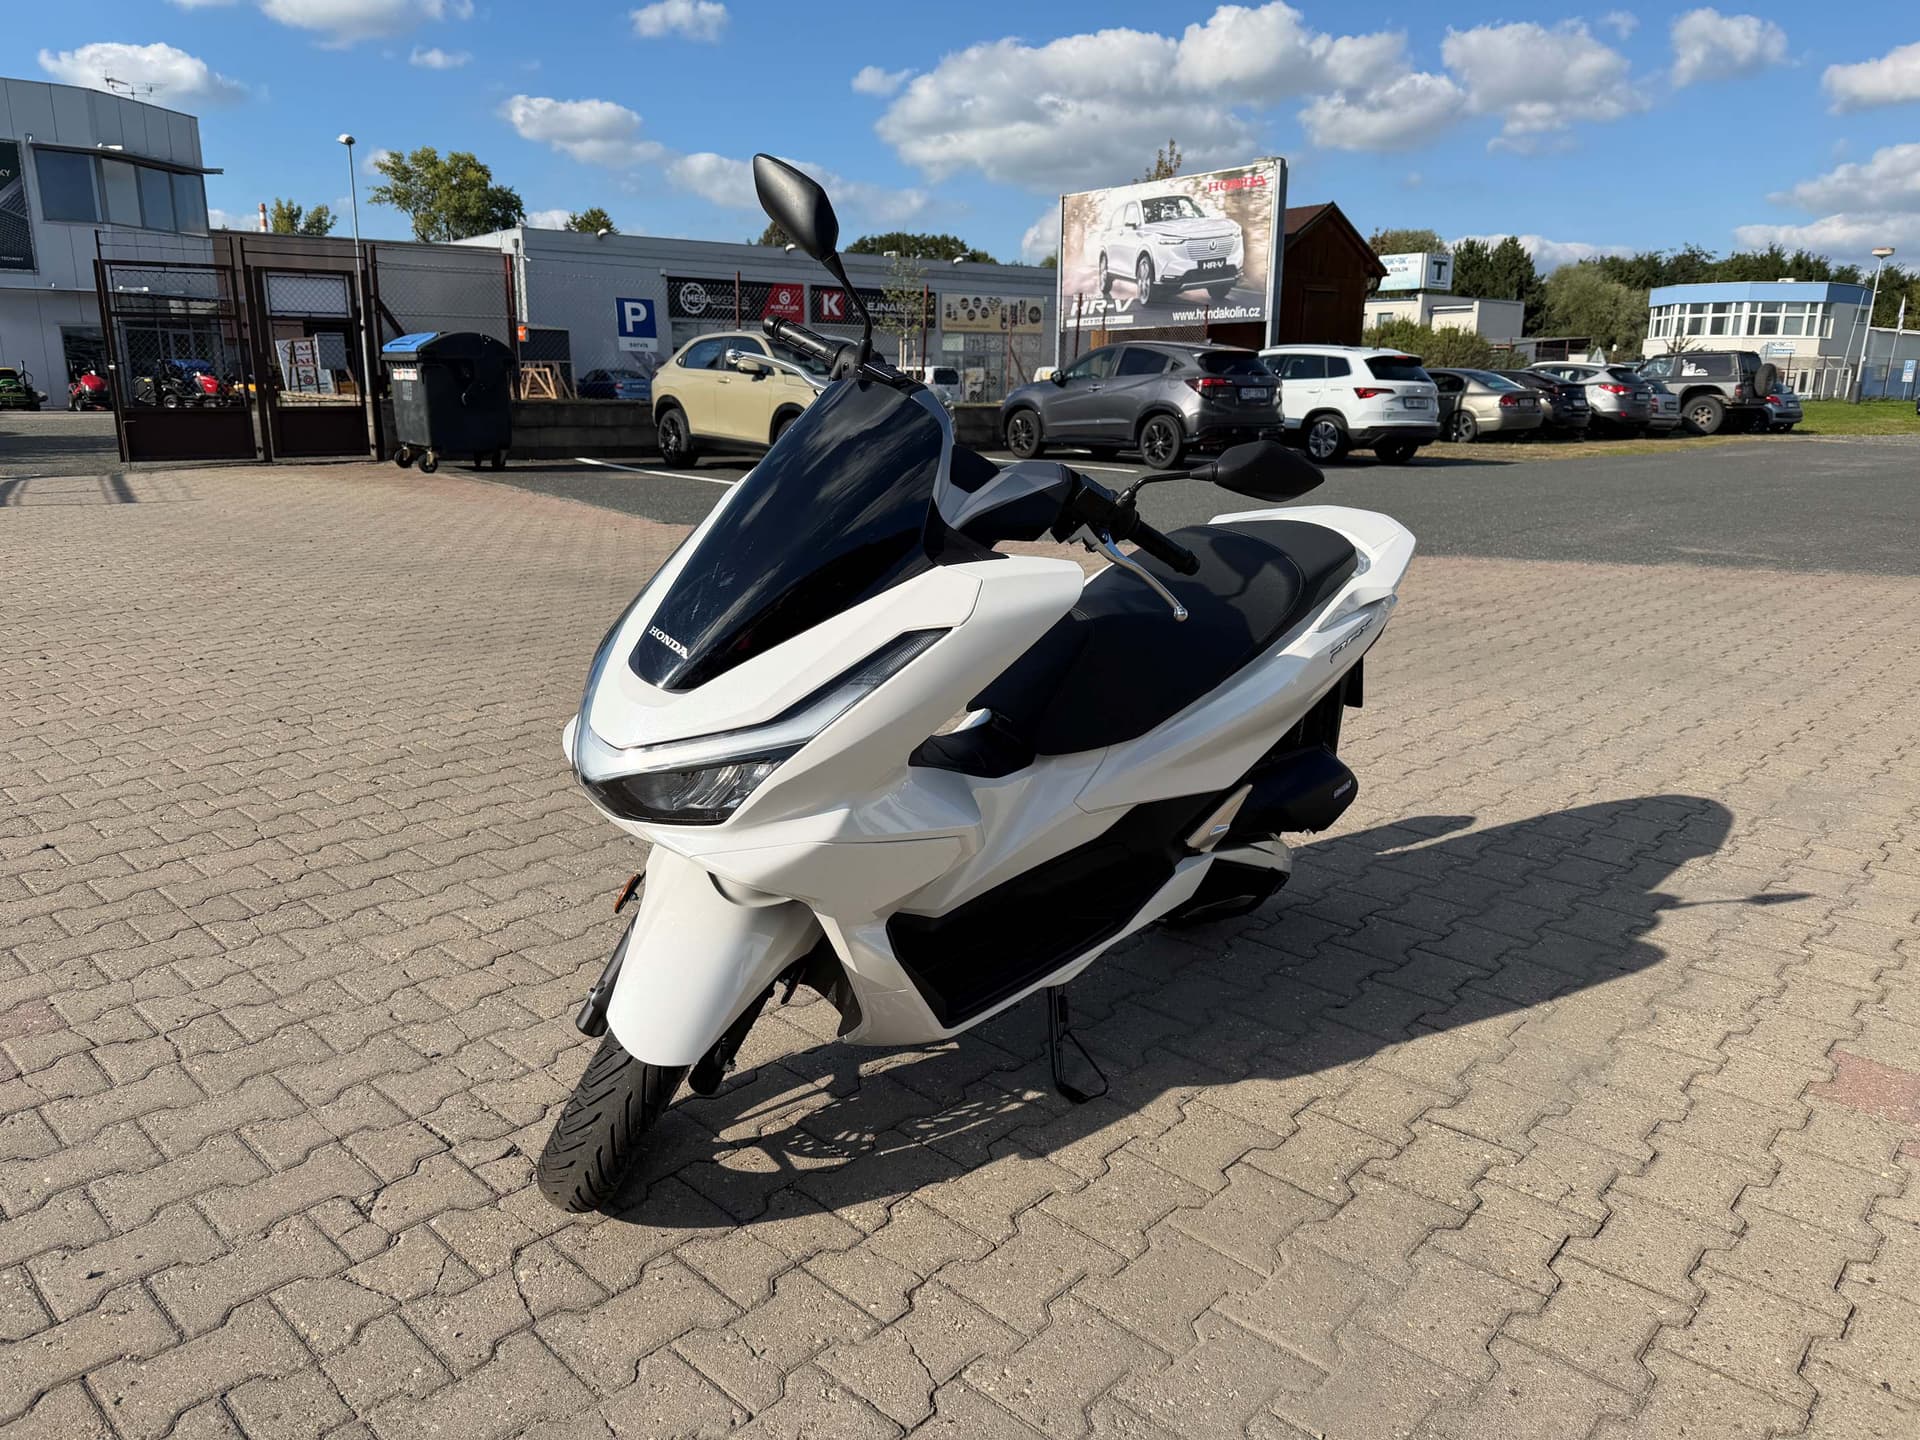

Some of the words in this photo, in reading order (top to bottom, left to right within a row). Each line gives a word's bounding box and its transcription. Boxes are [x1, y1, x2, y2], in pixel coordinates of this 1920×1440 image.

[1208, 175, 1267, 192] HONDA
[1202, 260, 1225, 270] HR-V
[823, 293, 841, 316] K
[1070, 297, 1135, 316] HR-V
[624, 301, 648, 333] P
[648, 625, 688, 660] HONDA
